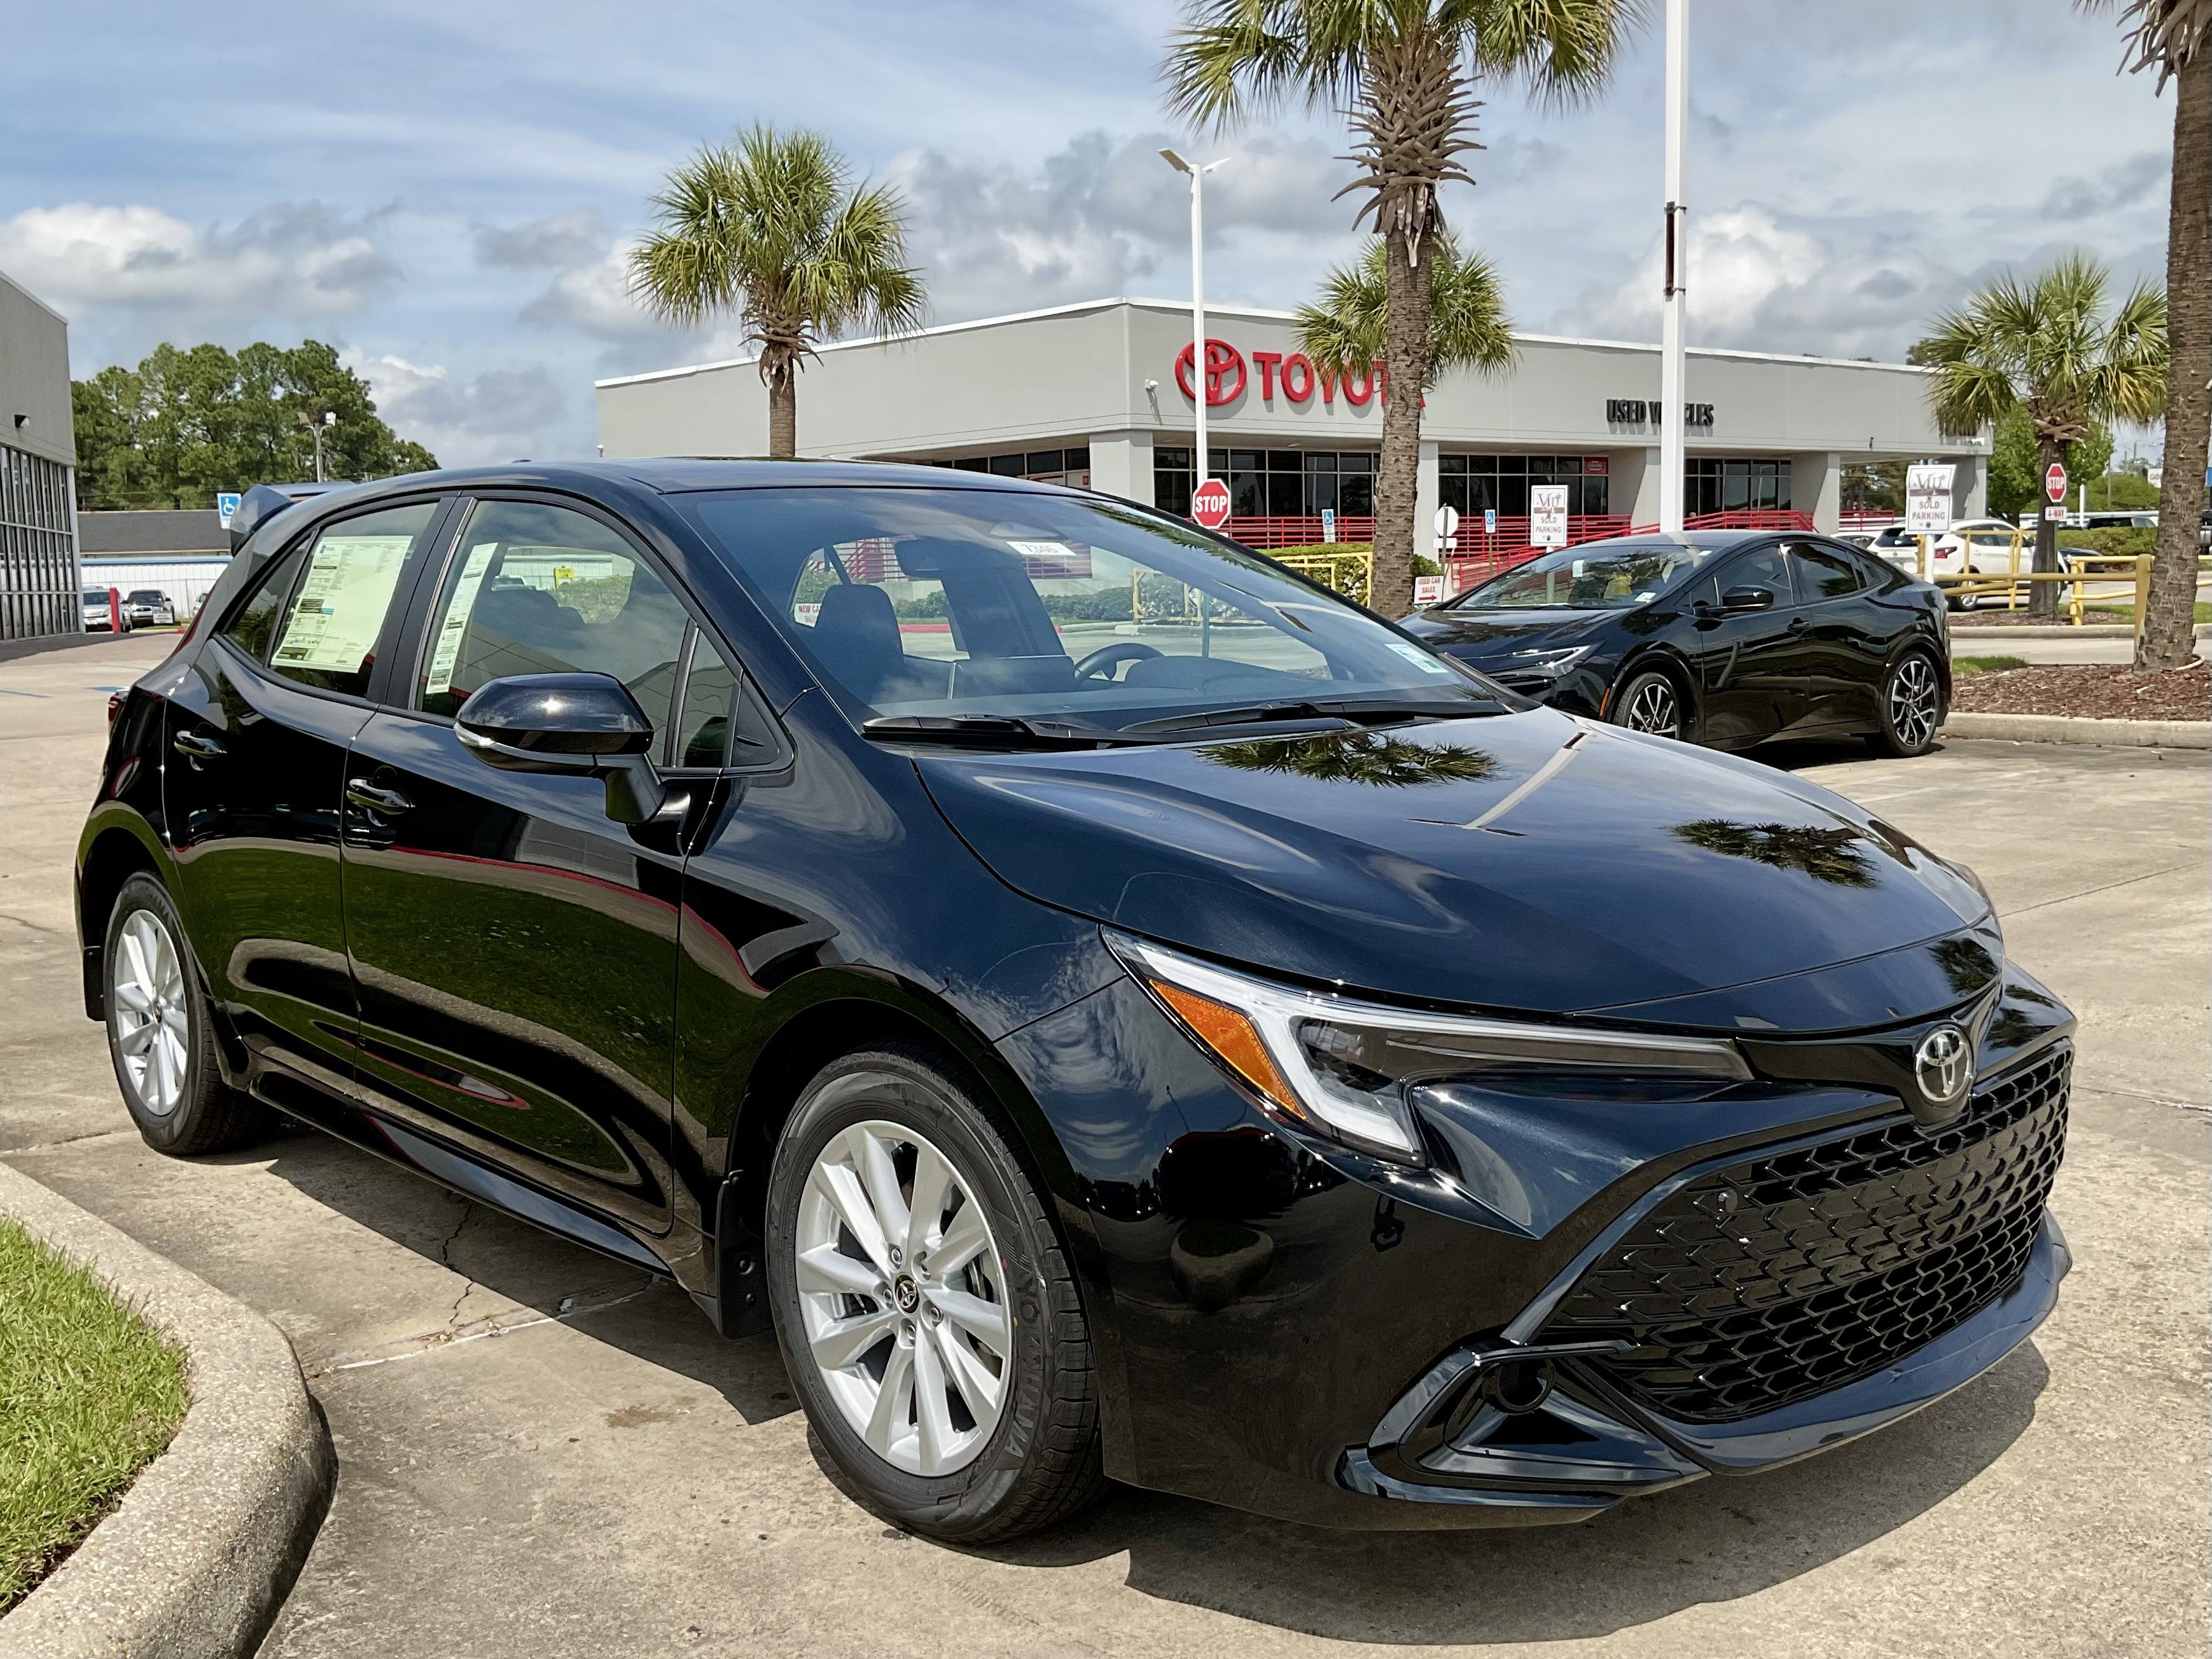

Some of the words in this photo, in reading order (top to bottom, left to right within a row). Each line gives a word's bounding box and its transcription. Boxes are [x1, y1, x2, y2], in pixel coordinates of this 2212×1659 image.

[1253, 352, 1426, 407] TOYOT
[1606, 399, 1646, 422] USED
[2048, 476, 2064, 489] STOP
[1195, 495, 1227, 513] STOP
